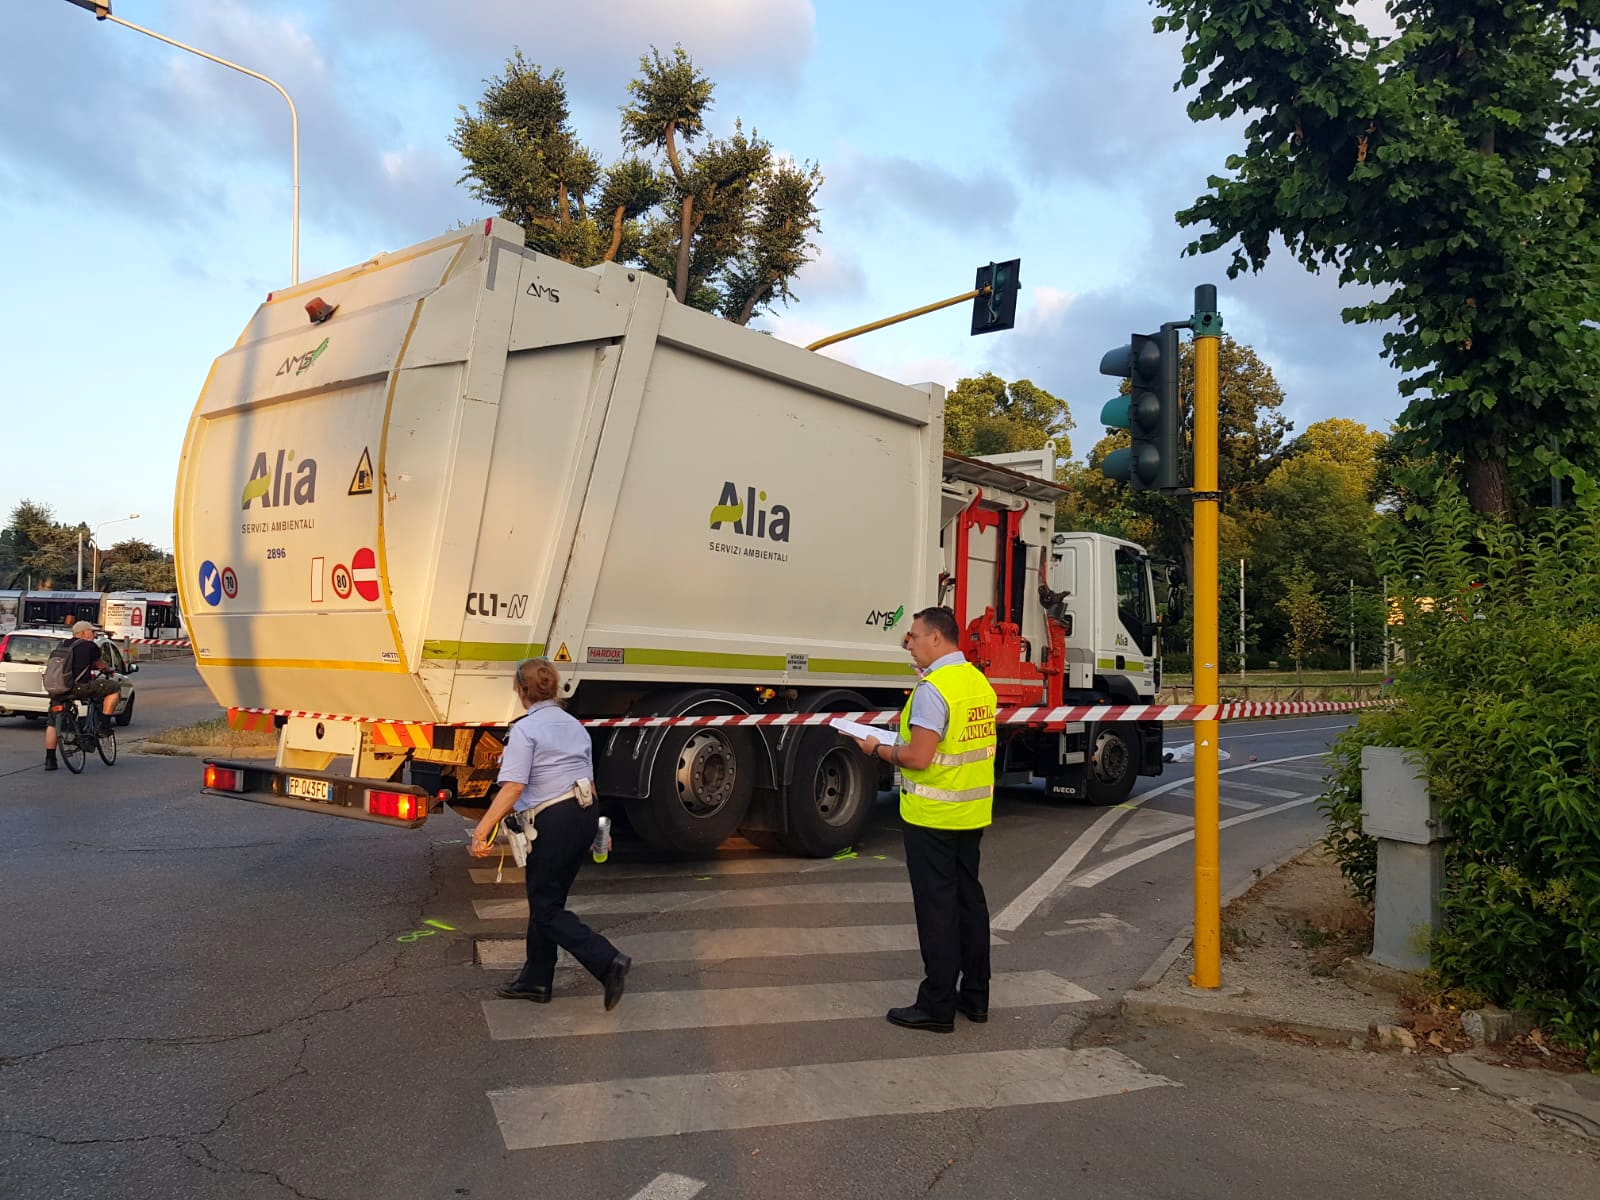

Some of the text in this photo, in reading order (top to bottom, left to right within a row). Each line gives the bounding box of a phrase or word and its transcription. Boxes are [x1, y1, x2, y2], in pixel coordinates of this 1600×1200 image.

[526, 282, 560, 303] AMS
[241, 449, 317, 510] Alia
[709, 481, 791, 543] Alia
[241, 519, 315, 534] SERVIZI AMBIENTALI
[266, 548, 287, 560] 2896
[709, 541, 789, 562] SERVIZI AMBIENTALI
[336, 574, 347, 588] 80
[590, 648, 621, 659] HARDOX
[1053, 786, 1076, 794] IVECO
